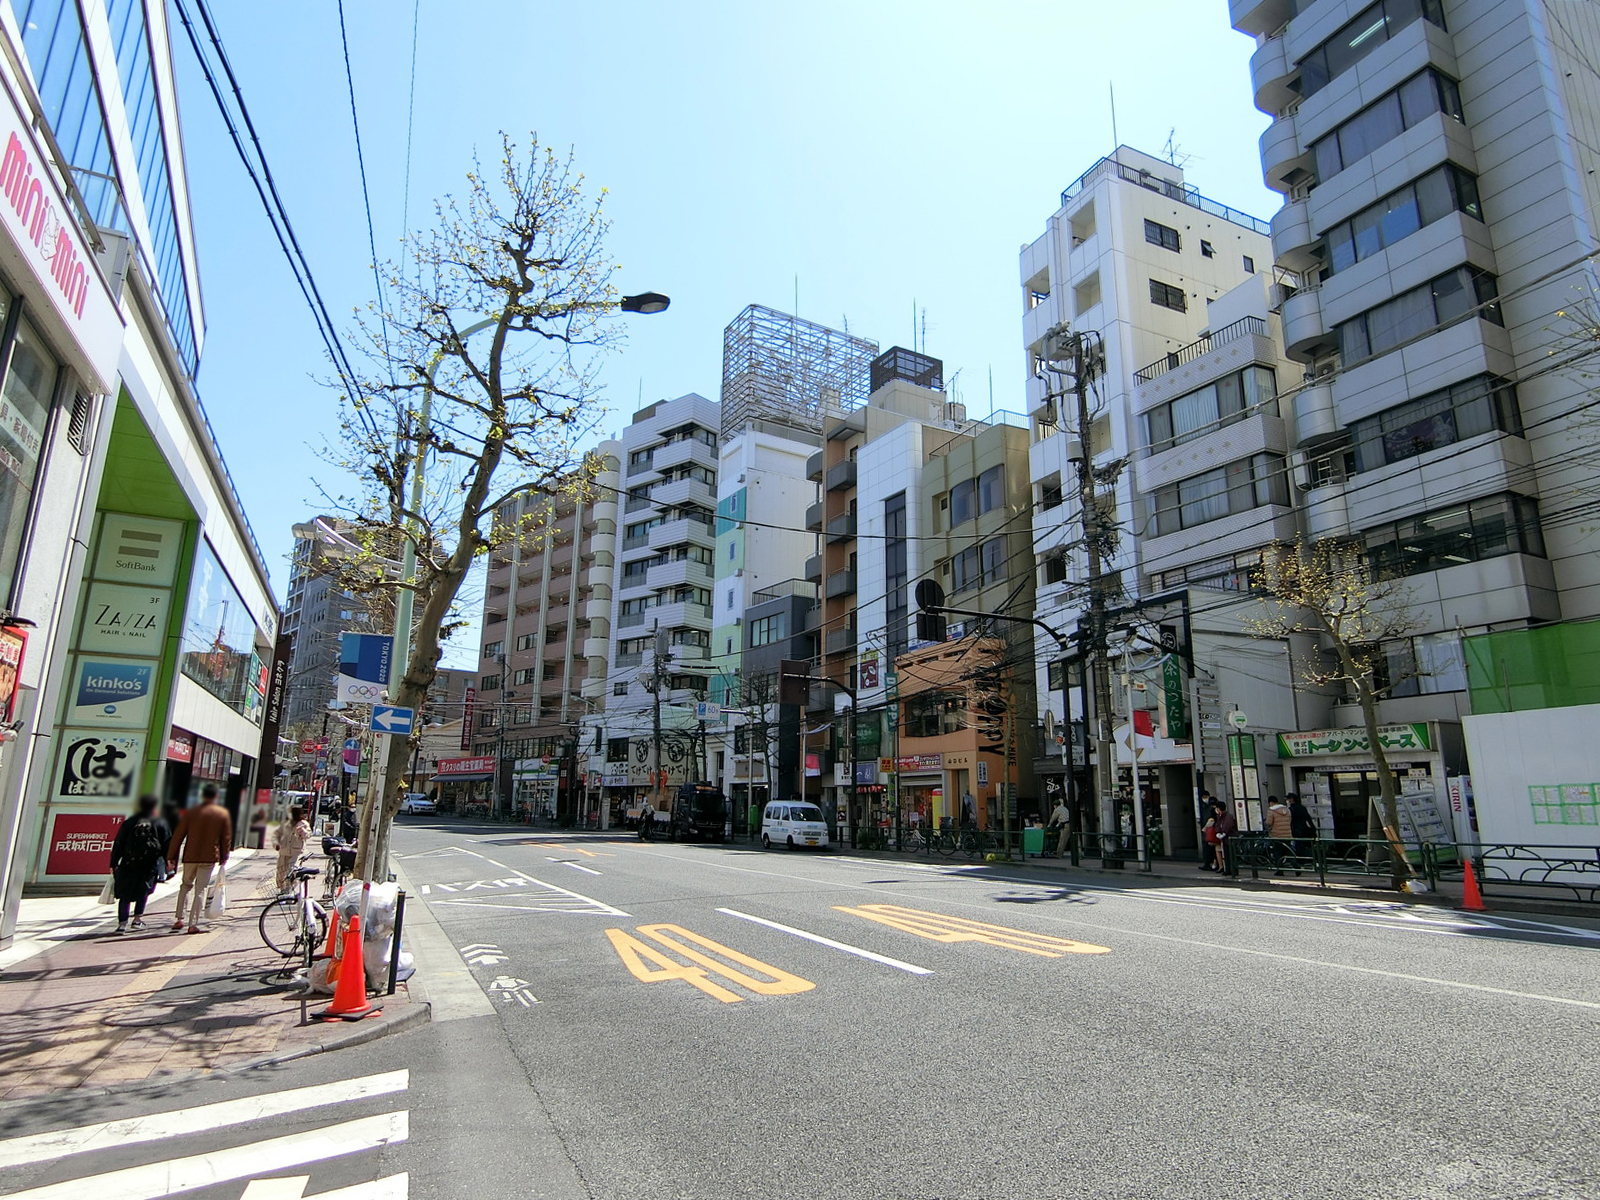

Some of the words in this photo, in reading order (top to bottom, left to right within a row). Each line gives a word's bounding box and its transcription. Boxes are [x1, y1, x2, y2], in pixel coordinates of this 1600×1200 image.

[0, 131, 49, 248] mini
[51, 226, 90, 321] mini
[116, 560, 156, 572] SoftBank
[381, 641, 390, 666] TOKYO
[87, 676, 142, 690] kinko's
[379, 666, 387, 682] 2020
[272, 686, 281, 706] Salon
[1164, 655, 1182, 731] 茶のつたや
[269, 707, 279, 723] Hair
[125, 741, 134, 749] 2F
[68, 780, 125, 795] はま
[1451, 785, 1461, 812] KIRIN
[828, 904, 1112, 958] 40
[604, 923, 817, 1004] 40
